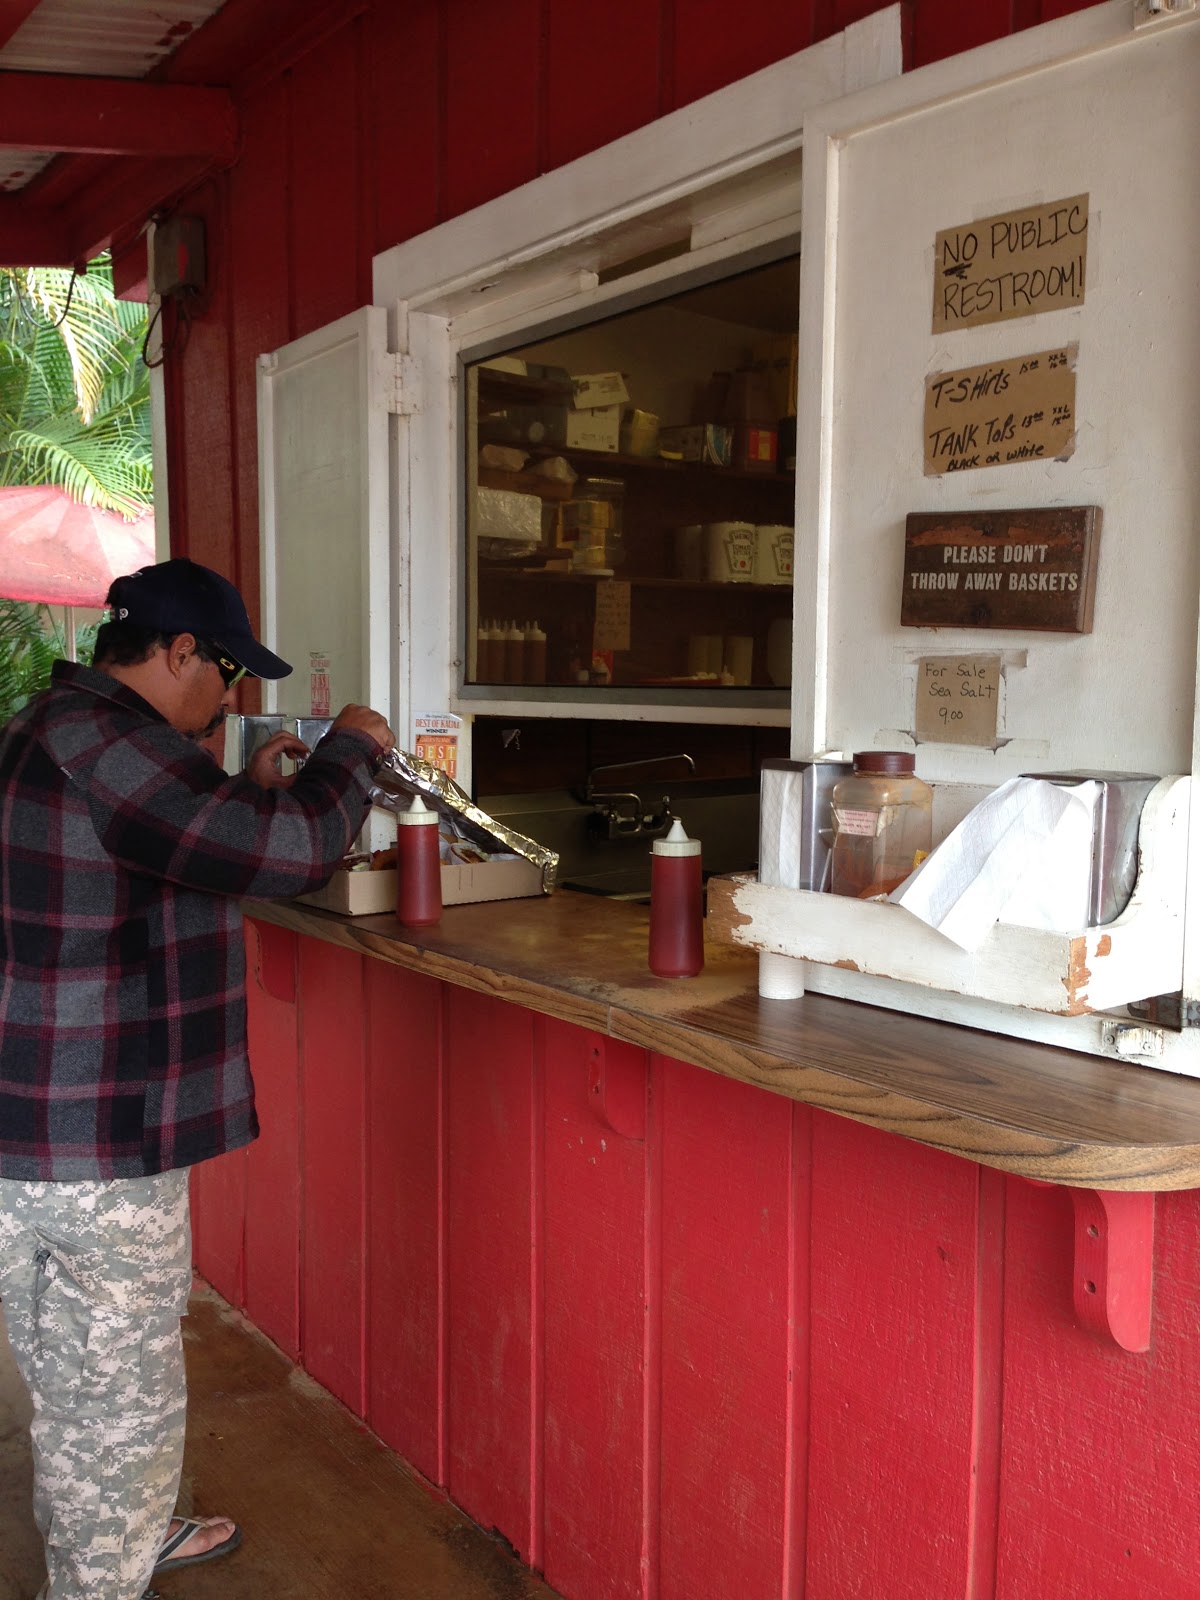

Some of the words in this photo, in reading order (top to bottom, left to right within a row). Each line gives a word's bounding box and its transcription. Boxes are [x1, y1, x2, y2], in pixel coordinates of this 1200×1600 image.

[944, 232, 978, 266] NO
[990, 205, 1088, 259] PUBLIC
[944, 256, 1083, 320] RESTROOM!
[929, 424, 980, 458] TANK
[946, 454, 980, 472] BLACK
[986, 452, 1000, 463] OR
[944, 546, 996, 564] PLEASE
[1003, 544, 1048, 562] DON'T
[911, 572, 959, 590] THROW
[964, 573, 1002, 590] AWAY
[1008, 572, 1078, 591] BASKETS
[925, 663, 948, 676] For
[956, 663, 986, 678] Sale
[928, 682, 952, 697] Sea
[416, 719, 430, 727] BEST
[432, 719, 439, 728] OF
[938, 708, 963, 725] 9.00
[417, 746, 455, 758] BEST
